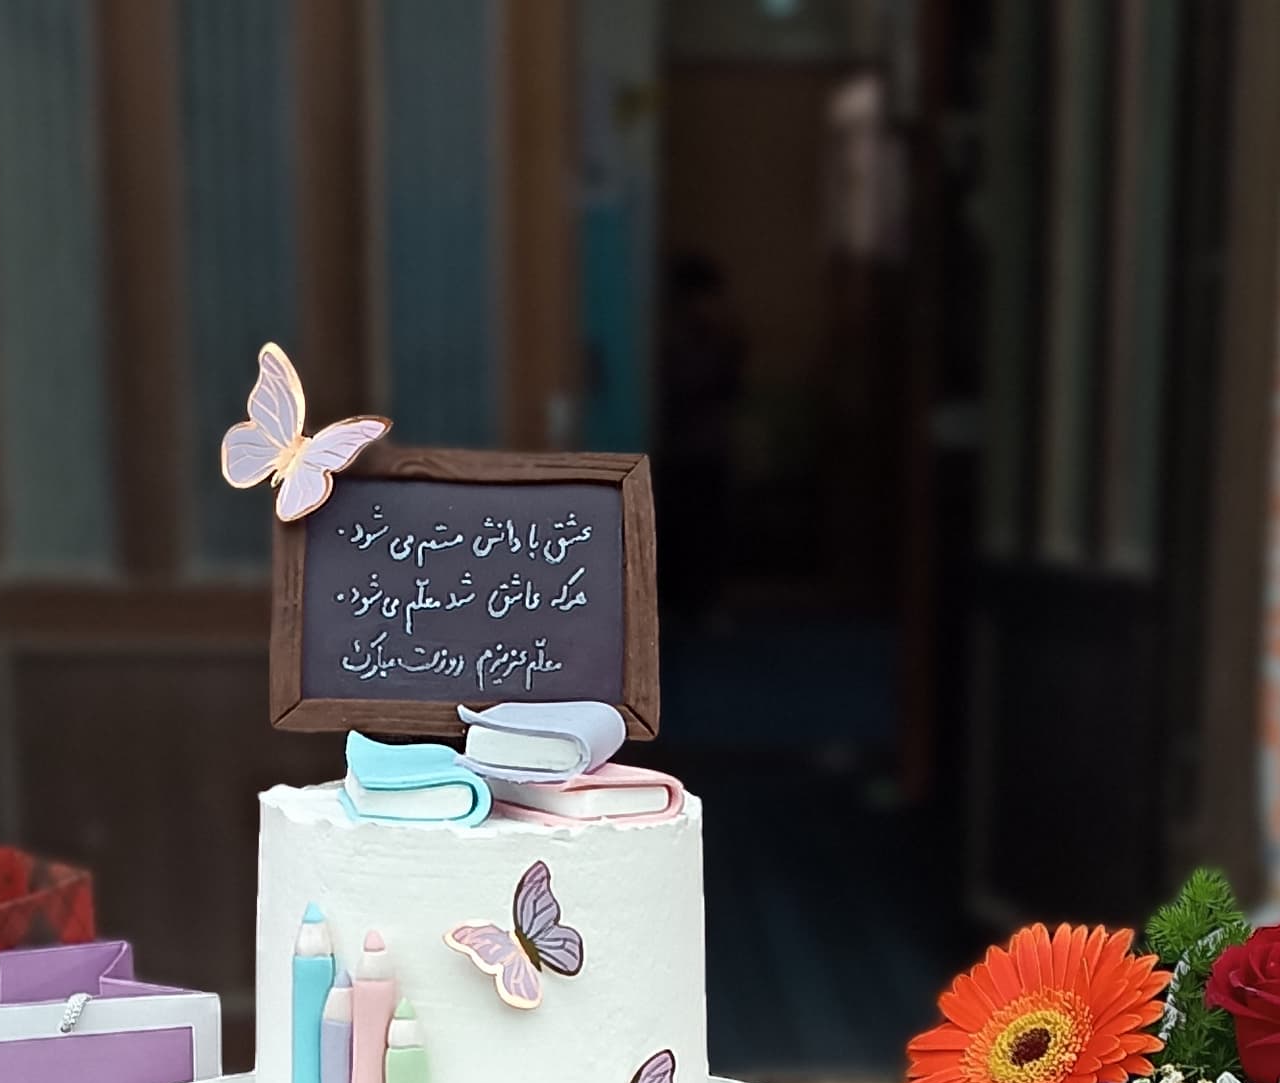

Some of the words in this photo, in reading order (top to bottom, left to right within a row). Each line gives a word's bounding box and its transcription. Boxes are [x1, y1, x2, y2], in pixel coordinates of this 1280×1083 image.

[473, 518, 521, 557] دانش
[529, 524, 539, 558] با
[544, 513, 592, 564] عشق
[445, 571, 476, 609] شد
[488, 573, 540, 617] عاشق
[551, 567, 587, 611] هرکه
[397, 647, 465, 677] روزت
[476, 644, 527, 691] عزیزم
